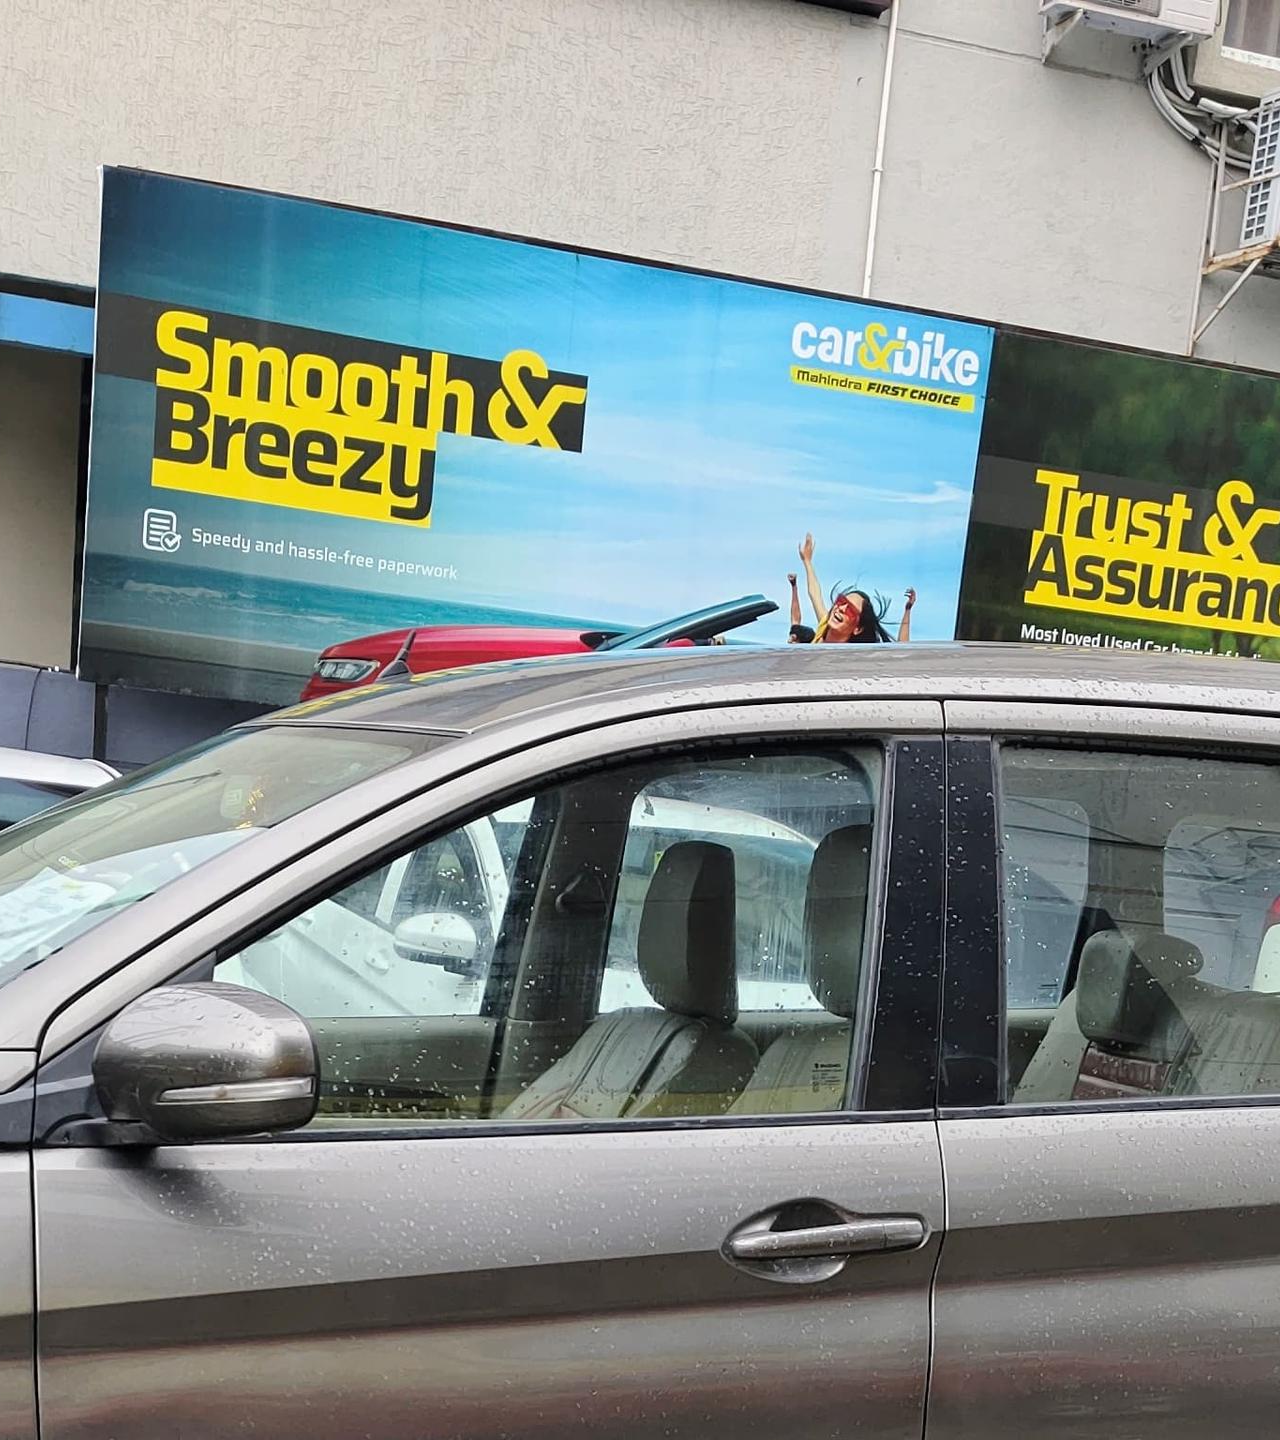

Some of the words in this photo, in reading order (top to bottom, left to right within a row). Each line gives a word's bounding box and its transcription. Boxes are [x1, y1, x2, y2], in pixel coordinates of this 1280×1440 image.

[156, 310, 475, 436] Smooth
[487, 348, 587, 450] &
[791, 321, 980, 386] car&bike
[796, 369, 862, 391] Mahindra
[866, 382, 910, 398] FIRST
[910, 389, 961, 407] CHOICE
[155, 388, 436, 521] Breezy
[1036, 469, 1193, 552] Trust
[192, 528, 251, 553] Speedy
[255, 540, 285, 555] and
[289, 541, 373, 568] hassle-free
[378, 557, 458, 580] paperwork
[1020, 623, 1058, 643] Most
[1062, 628, 1101, 647] loved
[1104, 634, 1142, 651] Used
